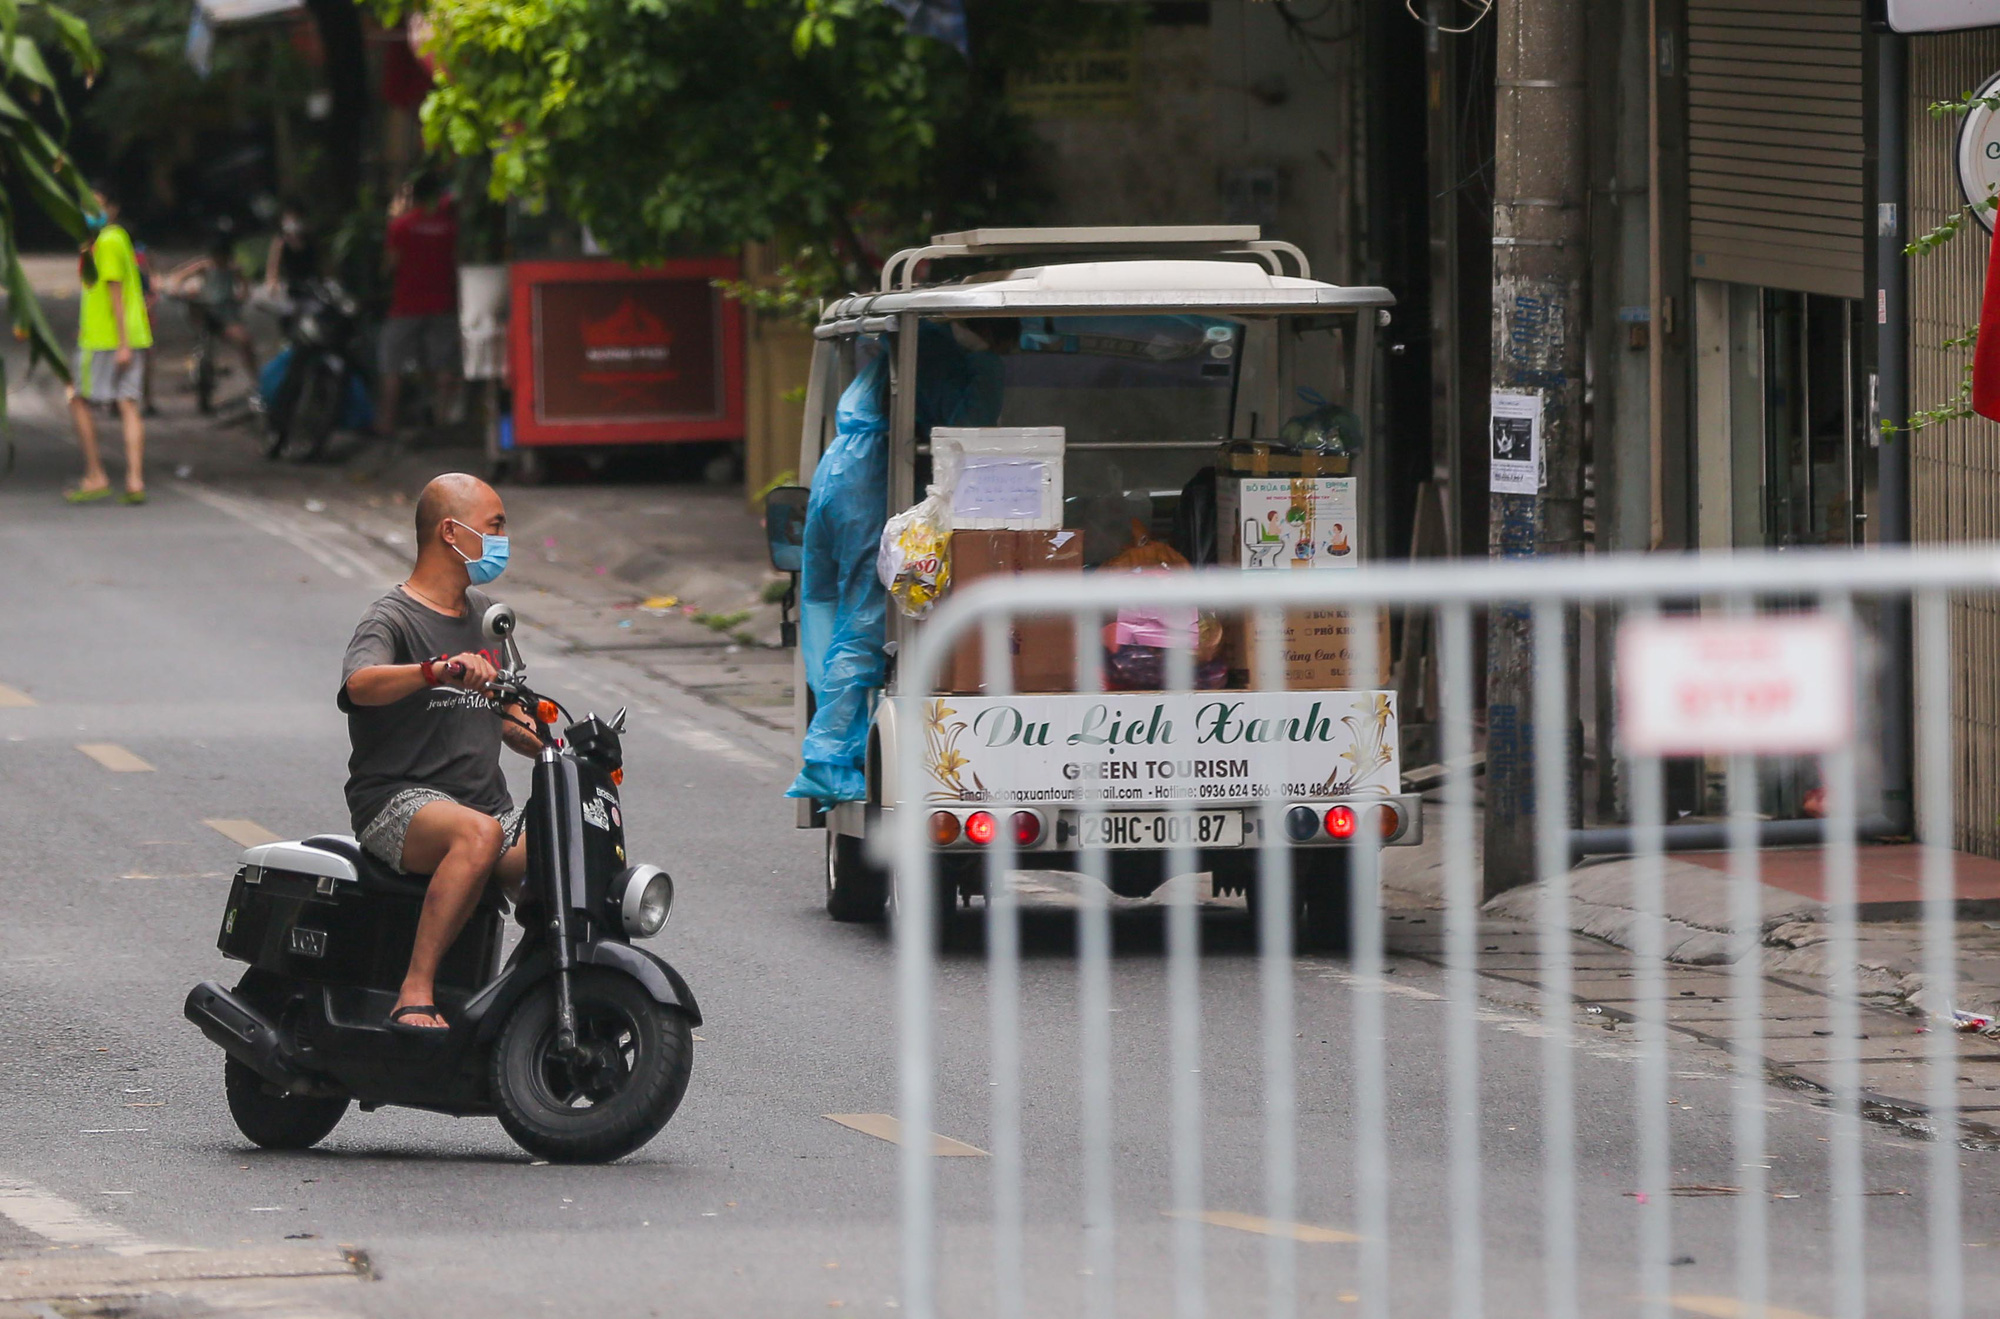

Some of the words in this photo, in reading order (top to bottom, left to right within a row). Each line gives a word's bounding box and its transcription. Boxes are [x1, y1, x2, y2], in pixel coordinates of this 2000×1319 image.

[973, 705, 1053, 748] Du
[1066, 704, 1177, 754] Lịch
[1196, 702, 1336, 745] Xanh
[1063, 760, 1138, 780] GREEN
[1145, 759, 1249, 779] TOURISM
[1199, 784, 1226, 798] 0936
[1229, 784, 1249, 797] 624
[1251, 783, 1271, 797] 566
[1281, 783, 1306, 796] 0943
[1084, 815, 1226, 844] 29HC-001.87
